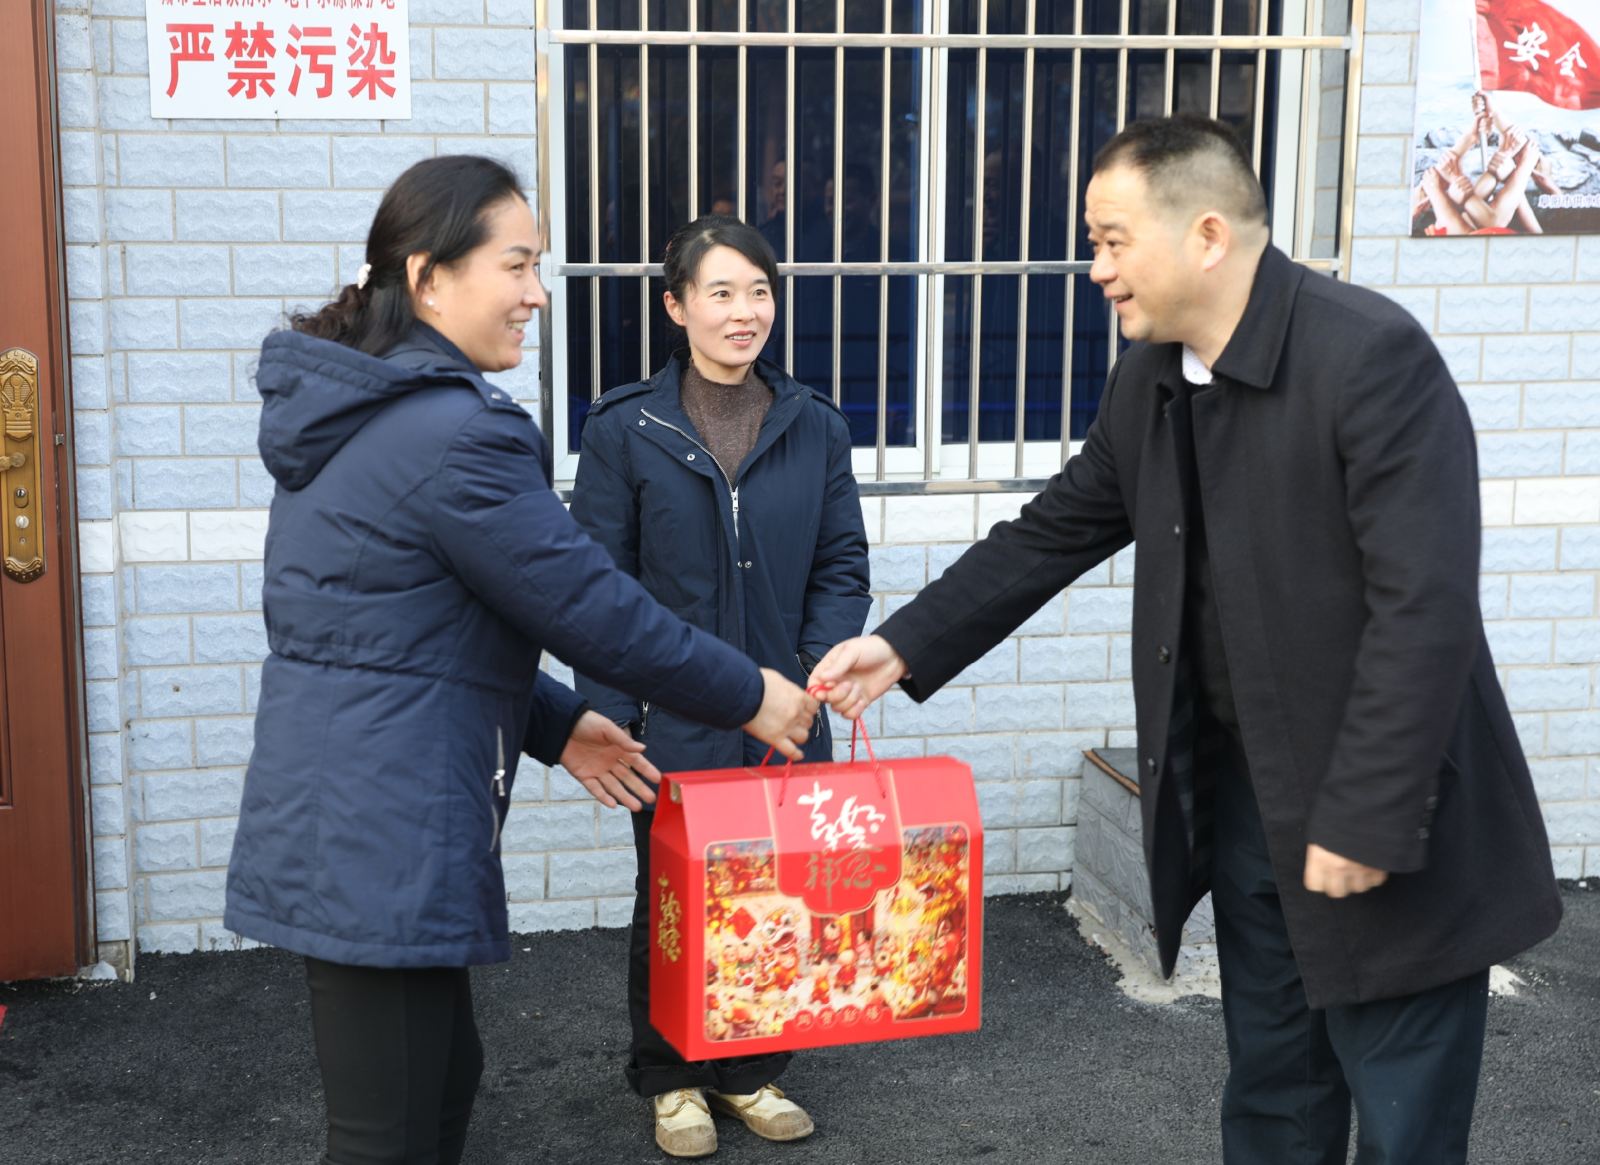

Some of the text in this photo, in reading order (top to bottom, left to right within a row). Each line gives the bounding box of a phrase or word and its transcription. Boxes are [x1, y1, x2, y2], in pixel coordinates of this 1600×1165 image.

[166, 21, 396, 100] 严禁污染
[1503, 21, 1588, 78] 安全
